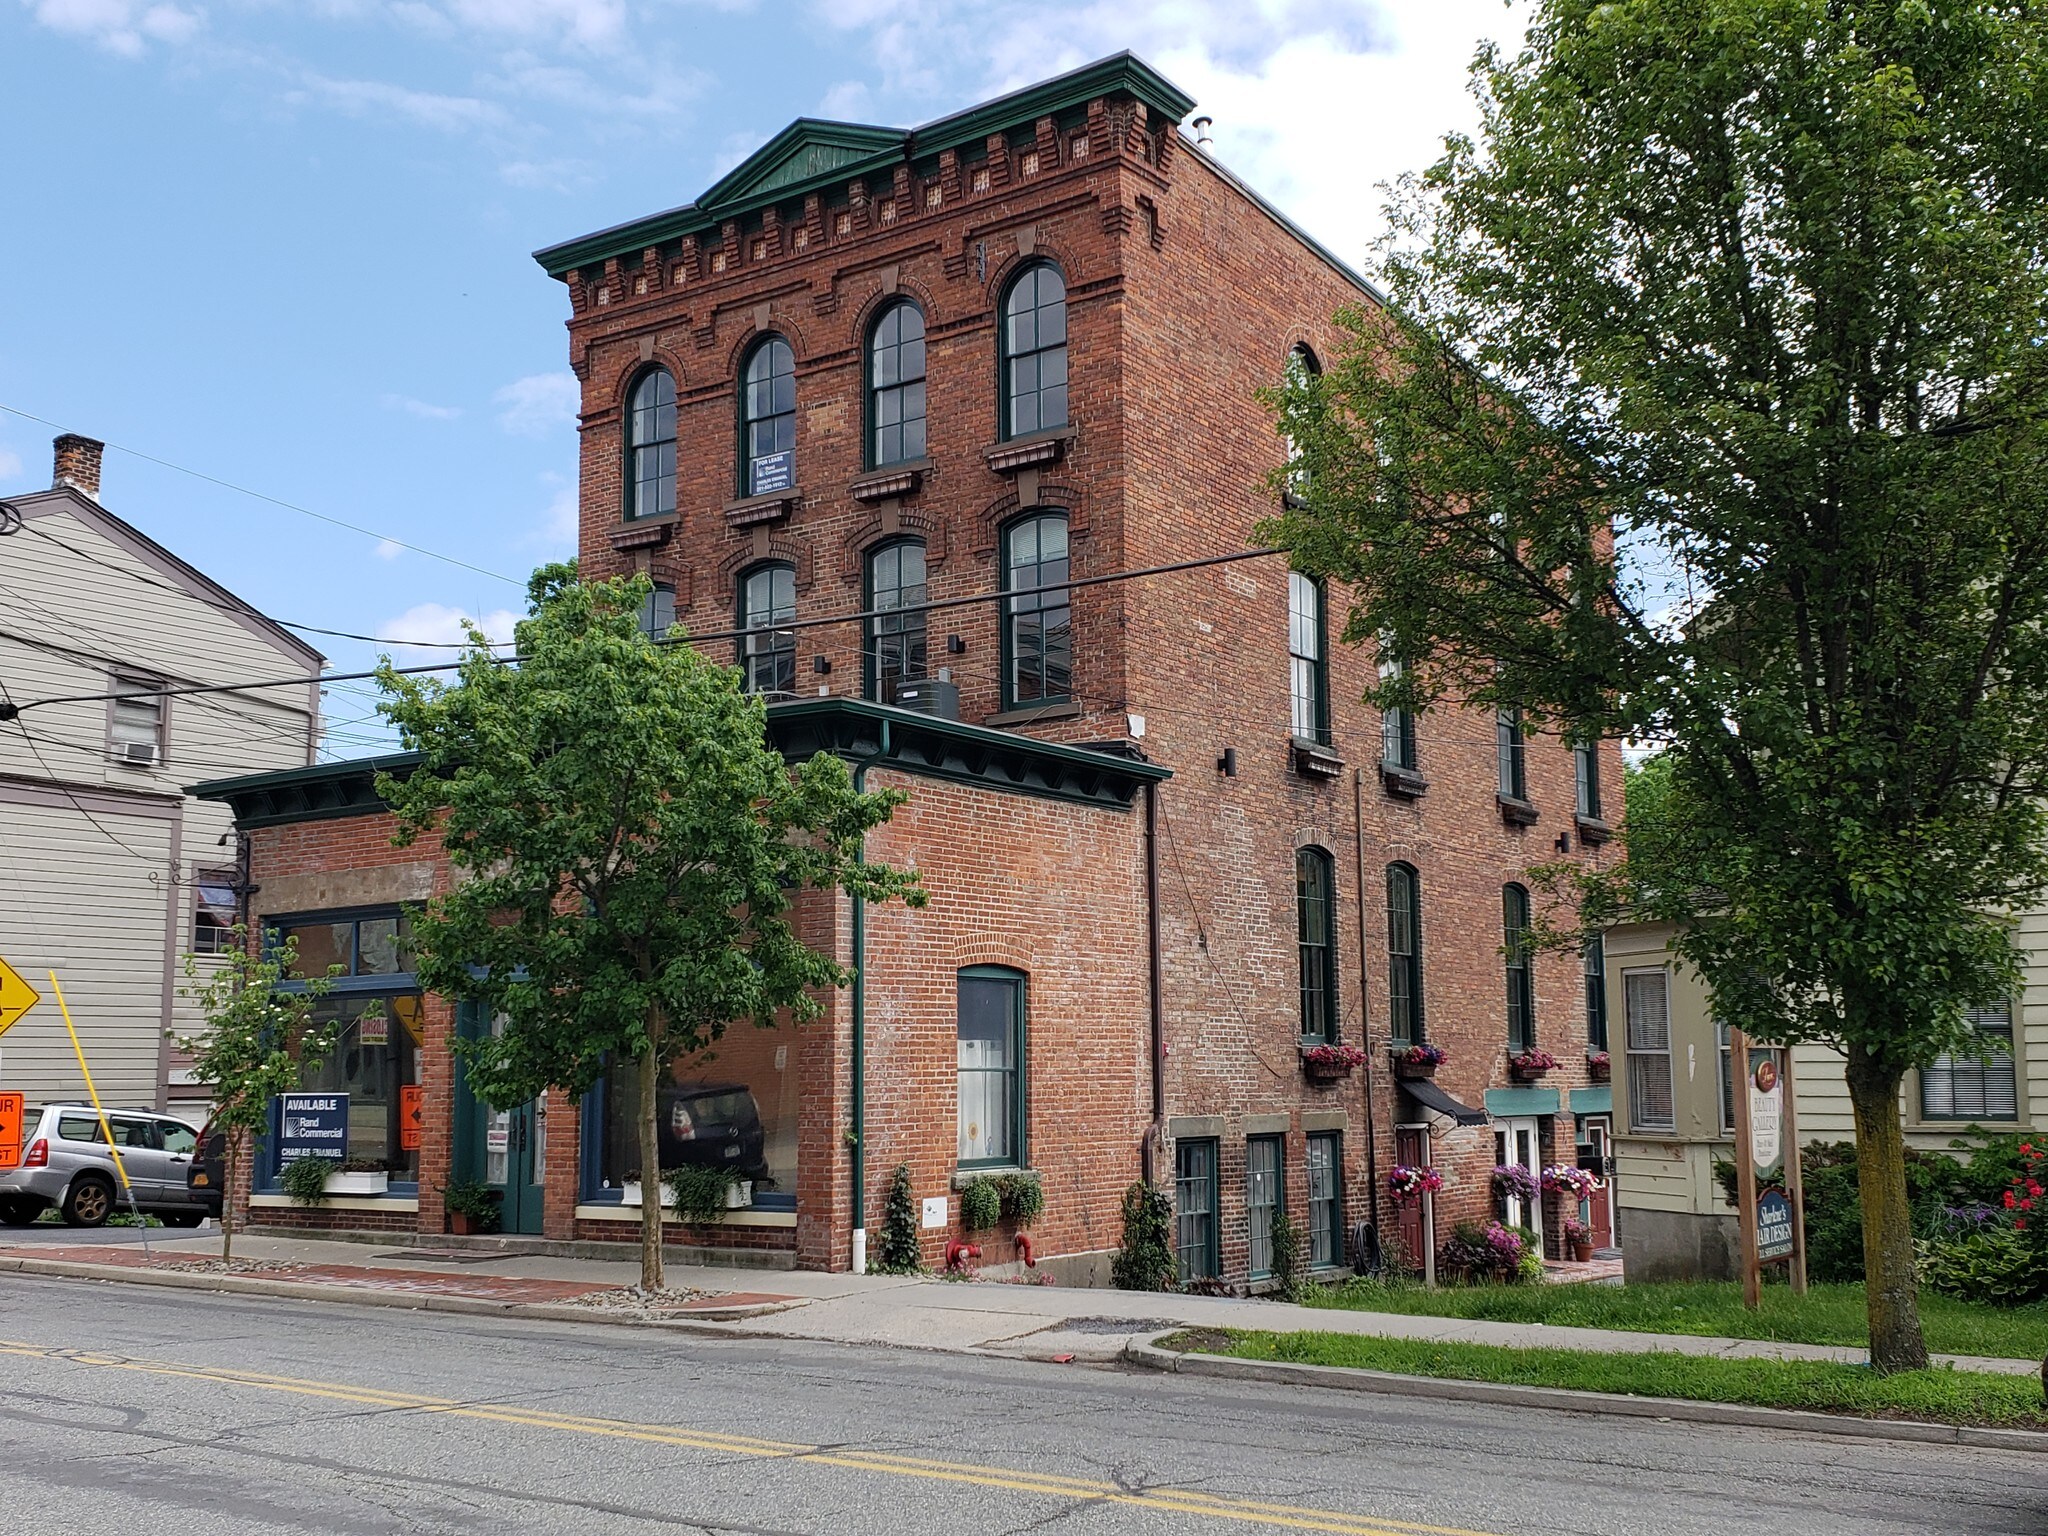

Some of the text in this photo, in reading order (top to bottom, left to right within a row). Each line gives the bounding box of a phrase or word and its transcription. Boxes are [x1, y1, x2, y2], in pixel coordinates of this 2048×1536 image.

[768, 455, 783, 463] LEASE
[287, 1099, 337, 1111] AVAILABLE
[300, 1117, 319, 1127] Rand
[300, 1127, 343, 1138] Commercial
[281, 1148, 311, 1157] CHARLES
[1770, 1222, 1792, 1243] DESIGN
